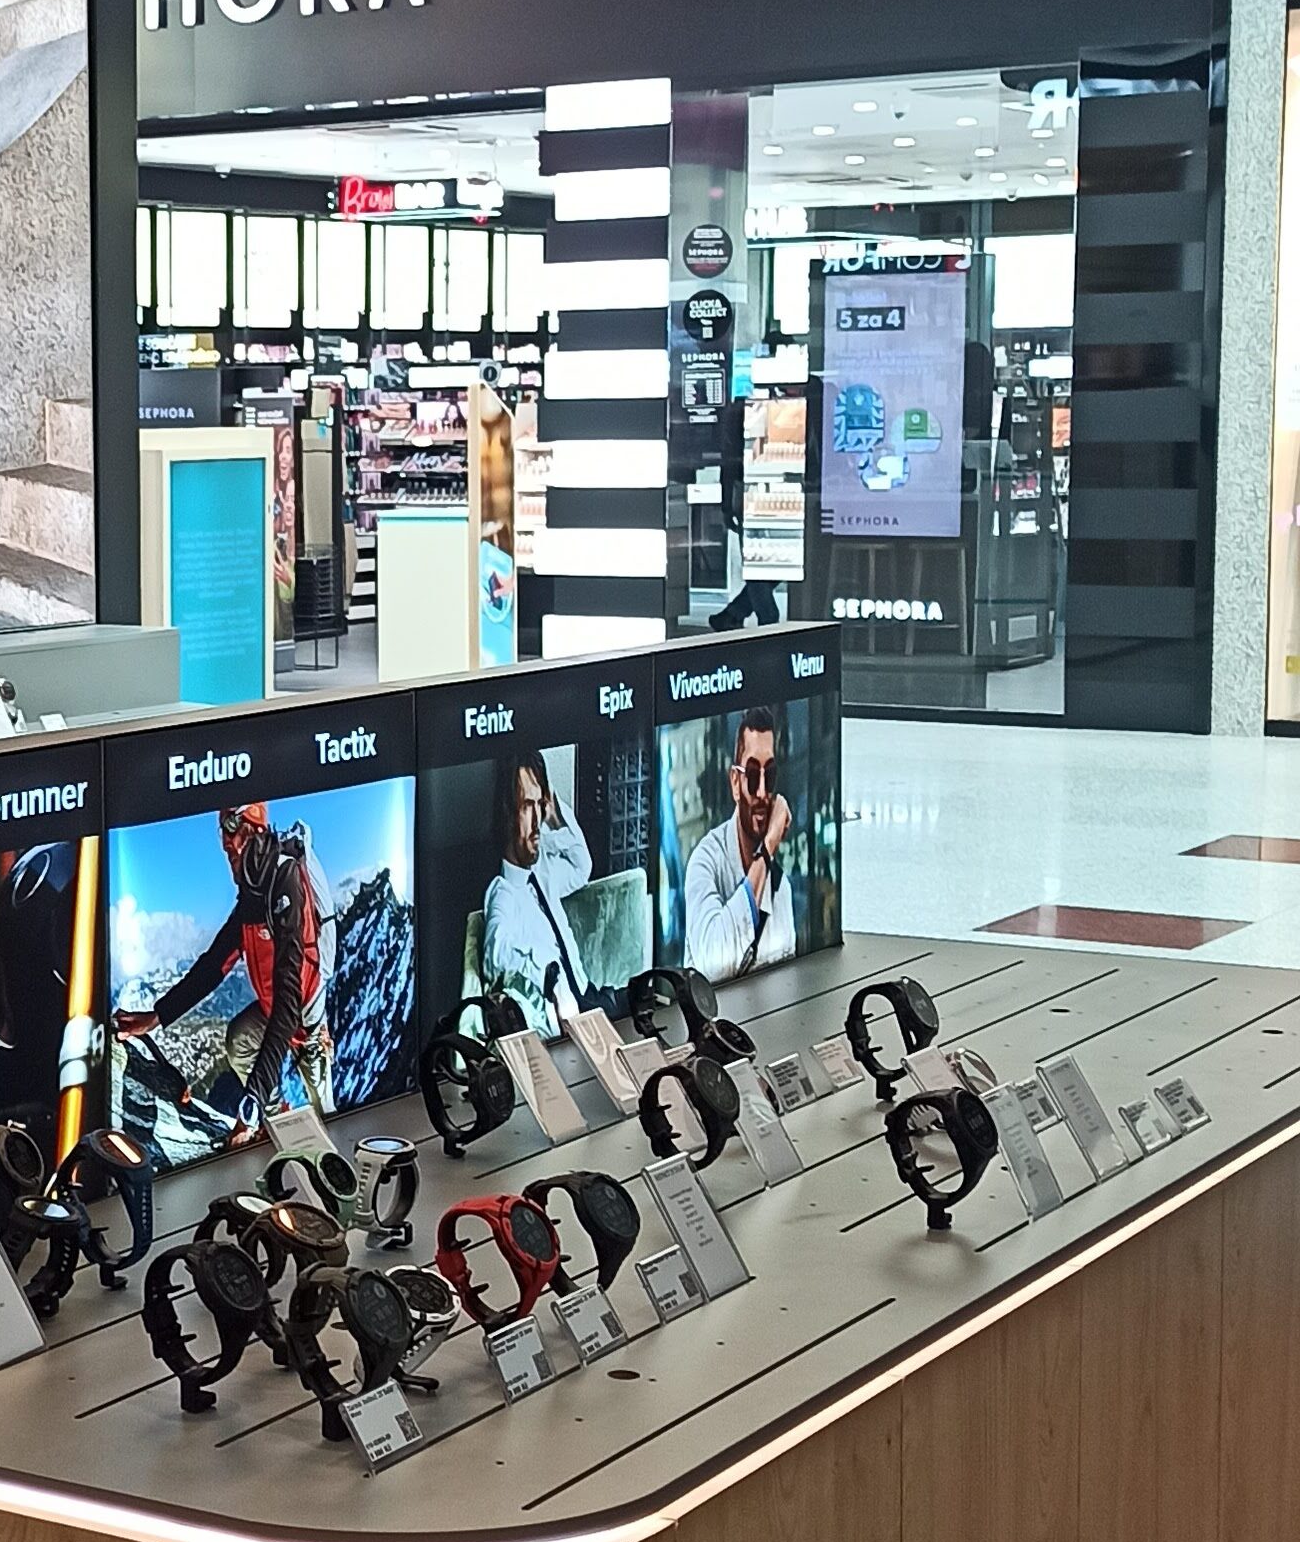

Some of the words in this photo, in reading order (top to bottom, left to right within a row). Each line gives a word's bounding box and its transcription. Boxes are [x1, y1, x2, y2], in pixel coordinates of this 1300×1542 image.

[839, 310, 852, 328] 5
[857, 313, 882, 328] za
[886, 309, 901, 327] 4
[840, 516, 899, 526] SEPHORA
[832, 597, 943, 621] SEPHORA
[791, 652, 825, 679] Venu
[598, 683, 634, 717] Epix
[464, 704, 515, 739] Fénix
[315, 726, 377, 765] Tactix
[169, 750, 252, 790] Enduro
